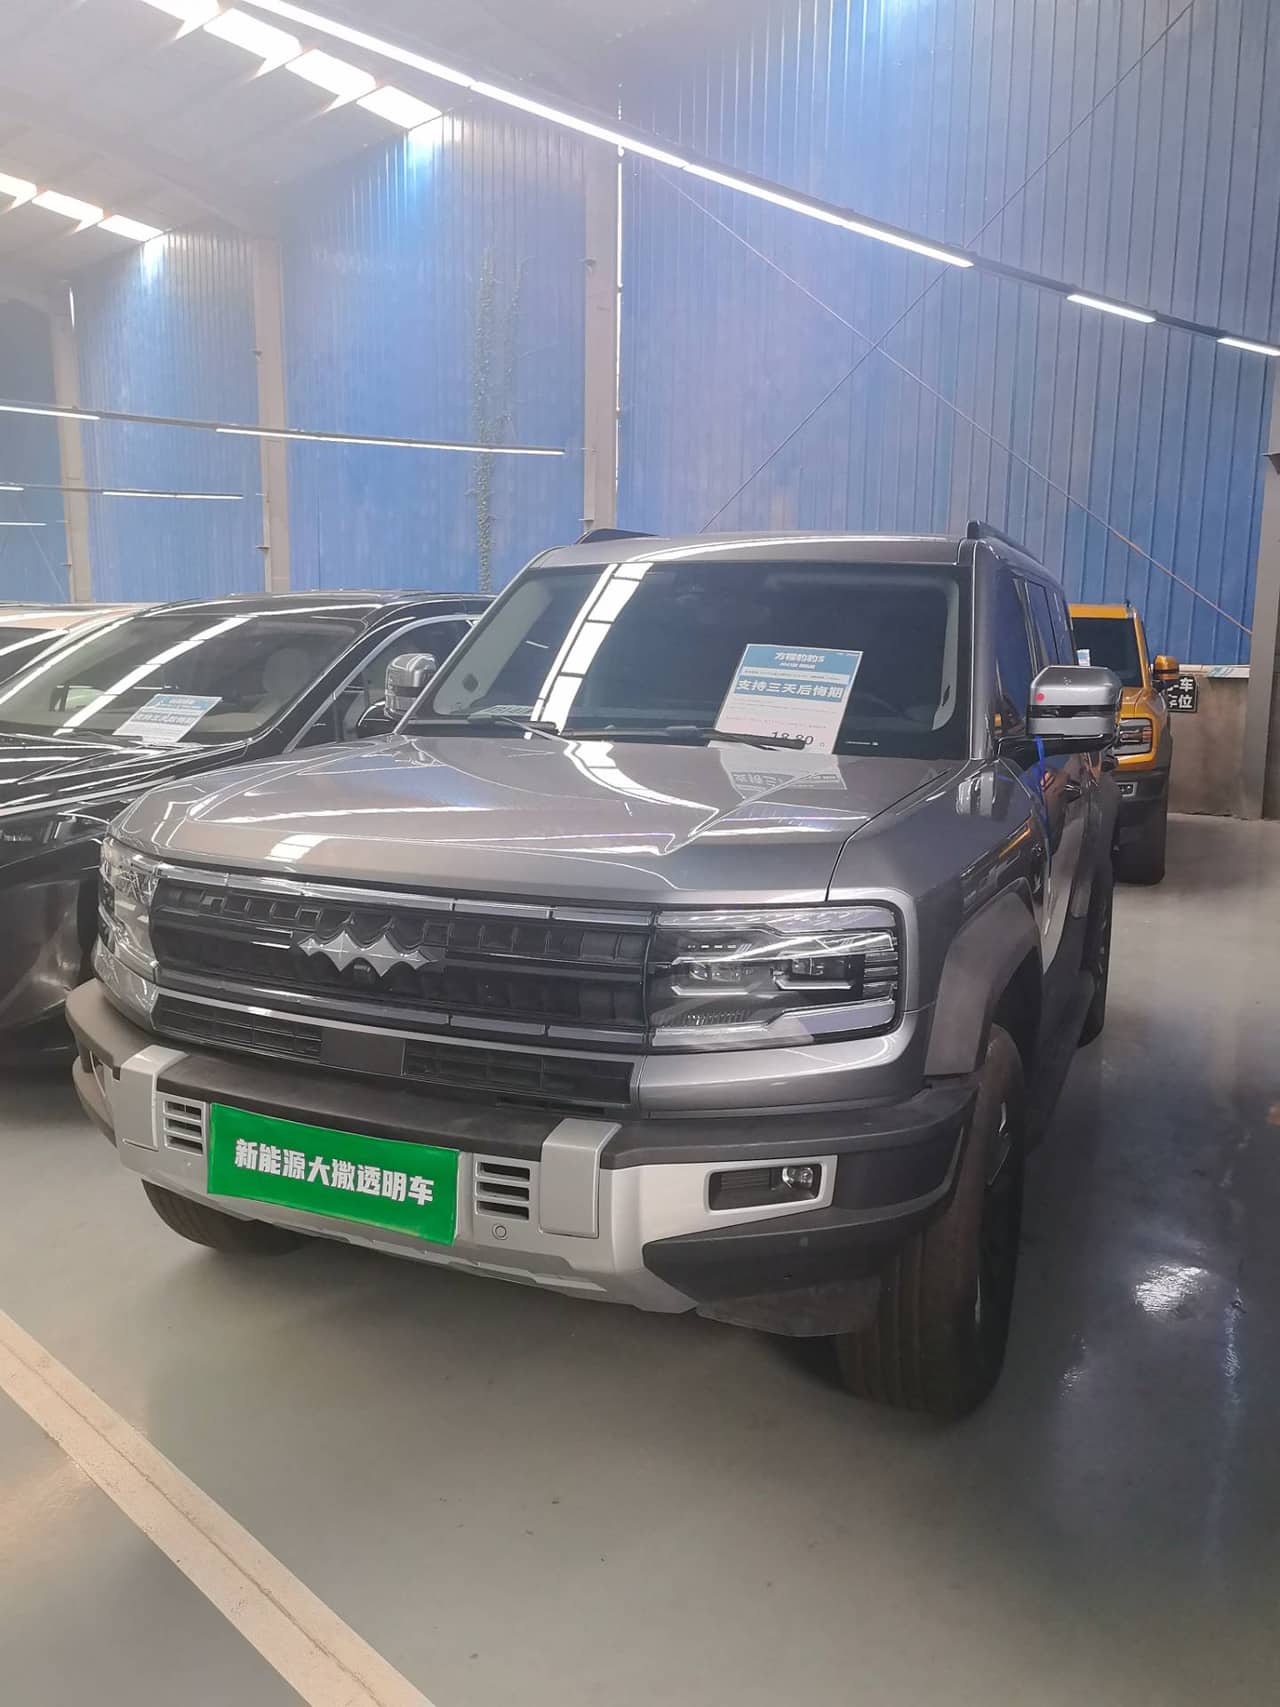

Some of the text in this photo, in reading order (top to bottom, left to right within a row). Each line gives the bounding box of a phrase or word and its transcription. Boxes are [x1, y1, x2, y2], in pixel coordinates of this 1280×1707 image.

[736, 679, 844, 698] 支持三天后悔期
[234, 1138, 435, 1206] 新能源大撒透明车
